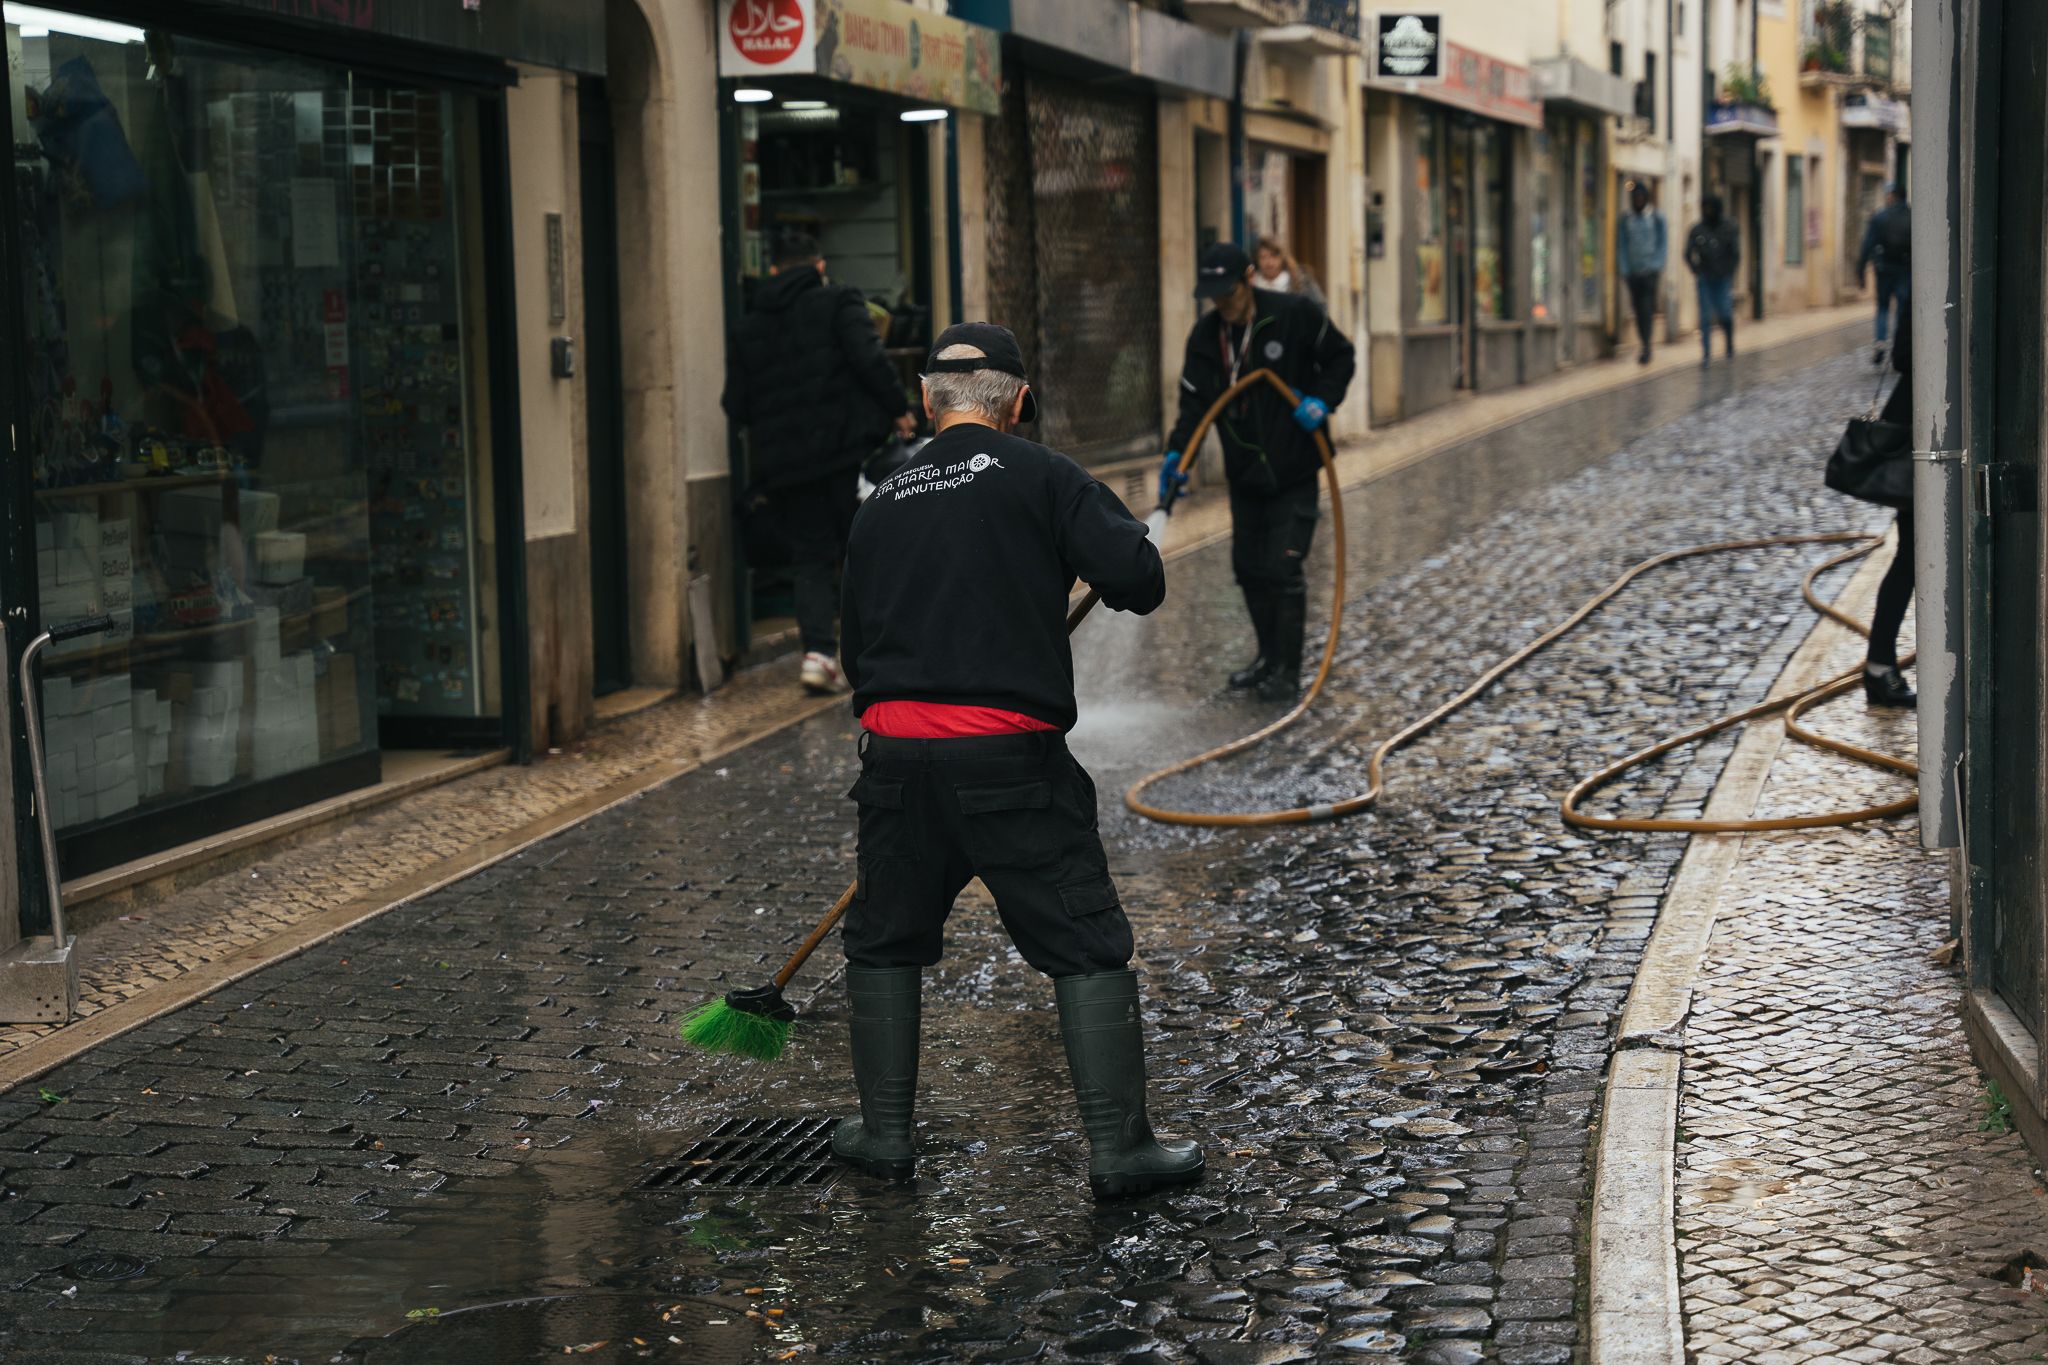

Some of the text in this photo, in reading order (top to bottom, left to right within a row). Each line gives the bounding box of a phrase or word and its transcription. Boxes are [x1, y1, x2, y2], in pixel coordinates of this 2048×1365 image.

[742, 36, 794, 51] HALAL
[897, 468, 941, 487] MARIA
[903, 463, 934, 477] FREGUESIA
[894, 472, 975, 501] MANUTENÇÃO
